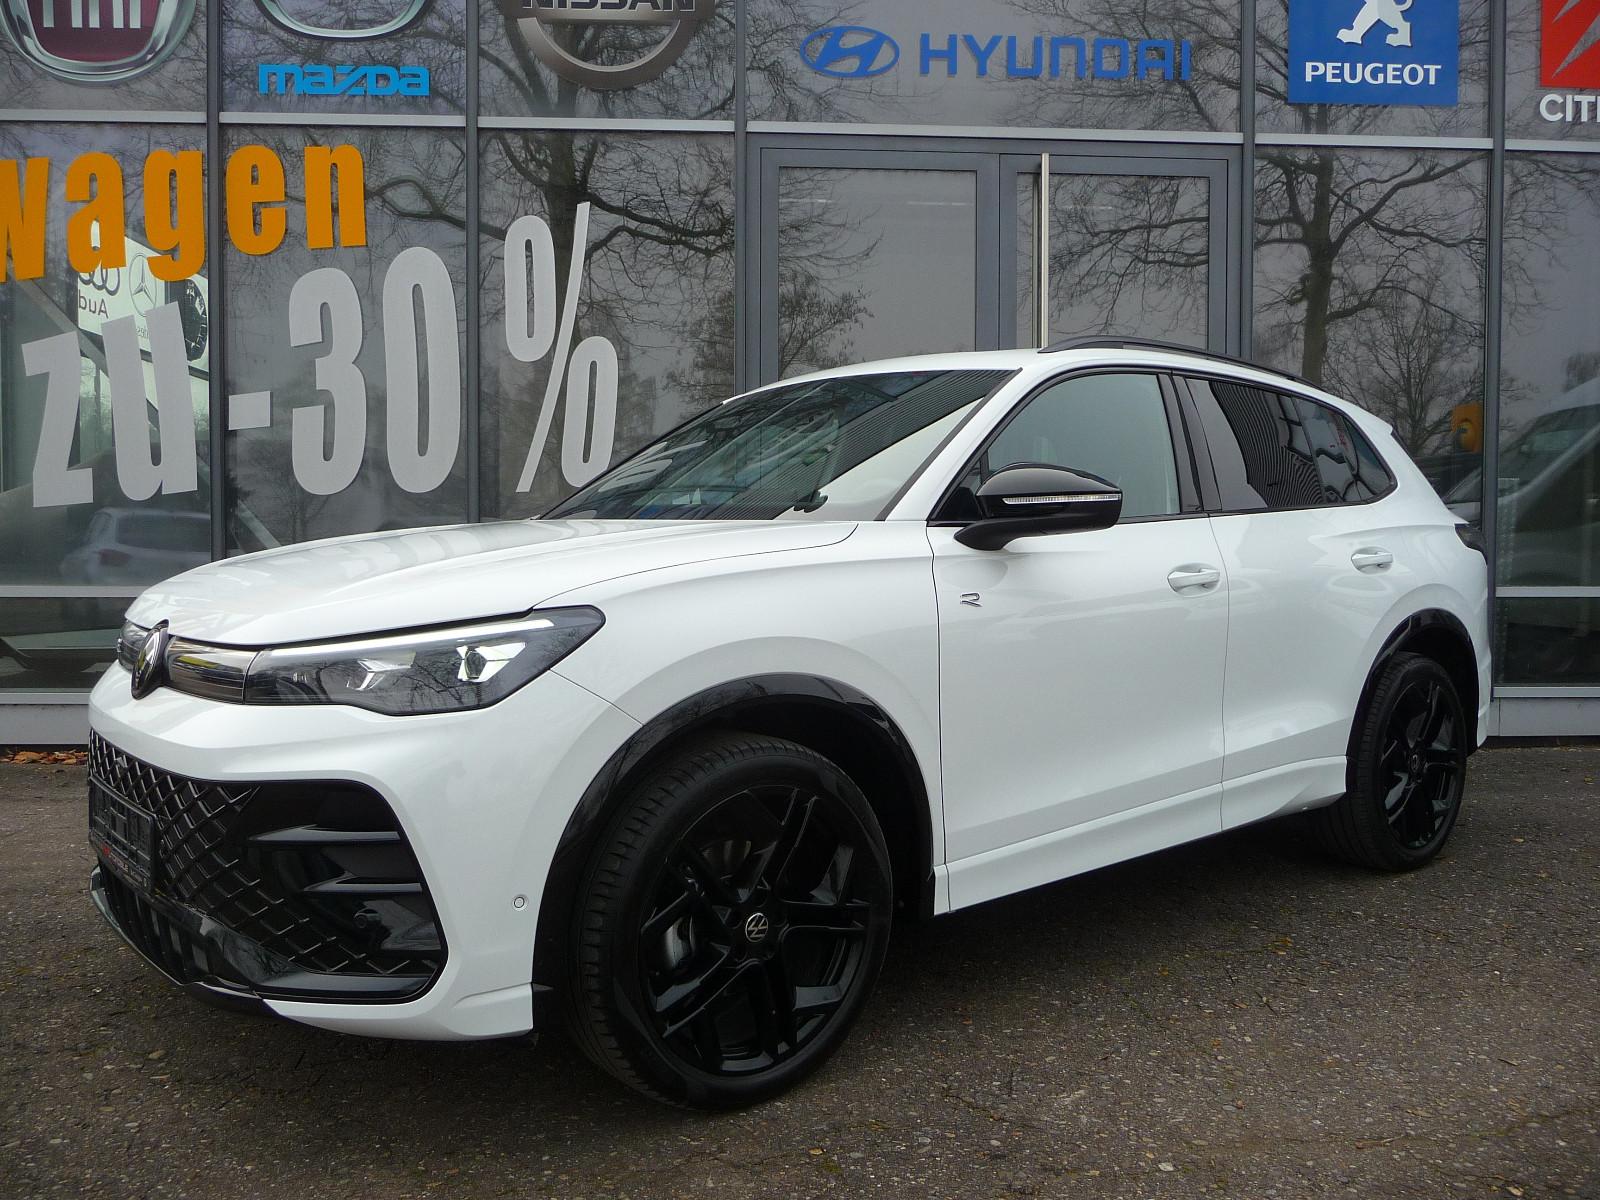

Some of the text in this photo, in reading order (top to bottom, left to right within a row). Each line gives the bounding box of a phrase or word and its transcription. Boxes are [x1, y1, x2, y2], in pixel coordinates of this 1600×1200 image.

[919, 33, 1192, 81] HYUNDAI
[1304, 61, 1442, 86] PEUGEOT
[1539, 94, 1600, 123] CIT
[22, 301, 198, 508] zu
